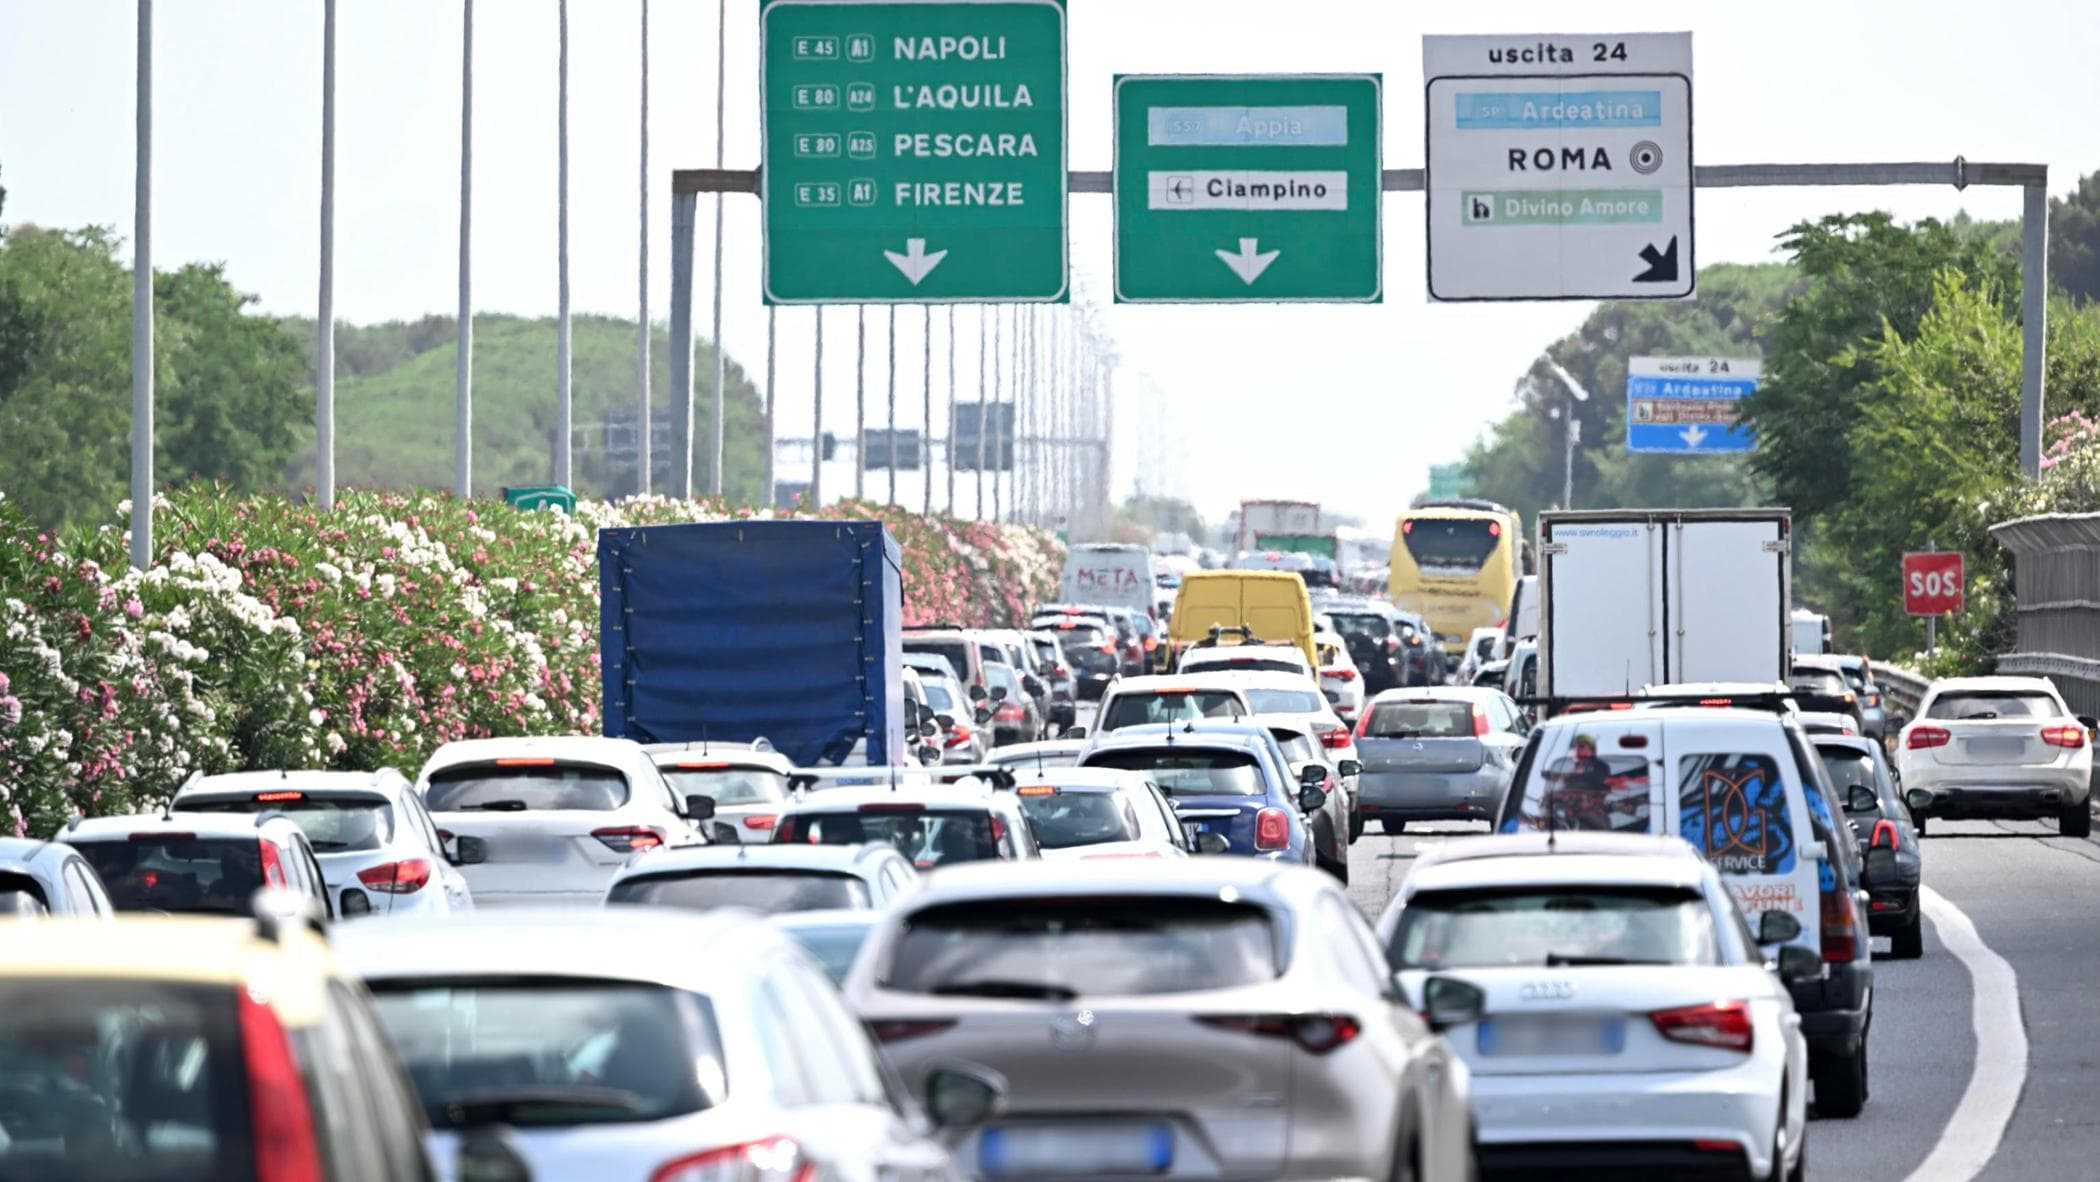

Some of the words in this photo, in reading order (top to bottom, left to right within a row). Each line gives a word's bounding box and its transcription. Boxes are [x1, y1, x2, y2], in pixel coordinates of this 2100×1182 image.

[797, 40, 808, 55] E
[815, 40, 833, 55] 45
[851, 38, 869, 57] A1
[893, 36, 1006, 60] NAPOLI
[1488, 43, 1573, 63] uscita
[1592, 42, 1627, 62] 24
[797, 88, 808, 105] E
[815, 88, 833, 105] 80
[849, 89, 873, 105] A24
[893, 85, 1034, 109] L'AQUILA
[1522, 101, 1644, 120] Ardeatina
[1236, 115, 1302, 137] Appia
[799, 137, 810, 153] E
[816, 137, 835, 153] 80
[850, 137, 874, 152] A25
[894, 133, 1038, 157] PESCARA
[1508, 147, 1613, 171] ROMA
[800, 186, 811, 202] E
[817, 186, 836, 202] 35
[854, 183, 871, 201] A1
[895, 182, 1024, 206] FIRENZE
[1207, 178, 1327, 201] Ciampino
[1505, 198, 1573, 217] Divino
[1579, 197, 1650, 216] Amore
[1710, 360, 1729, 373] 24
[1077, 568, 1138, 586] META
[1910, 570, 1956, 597] SOS
